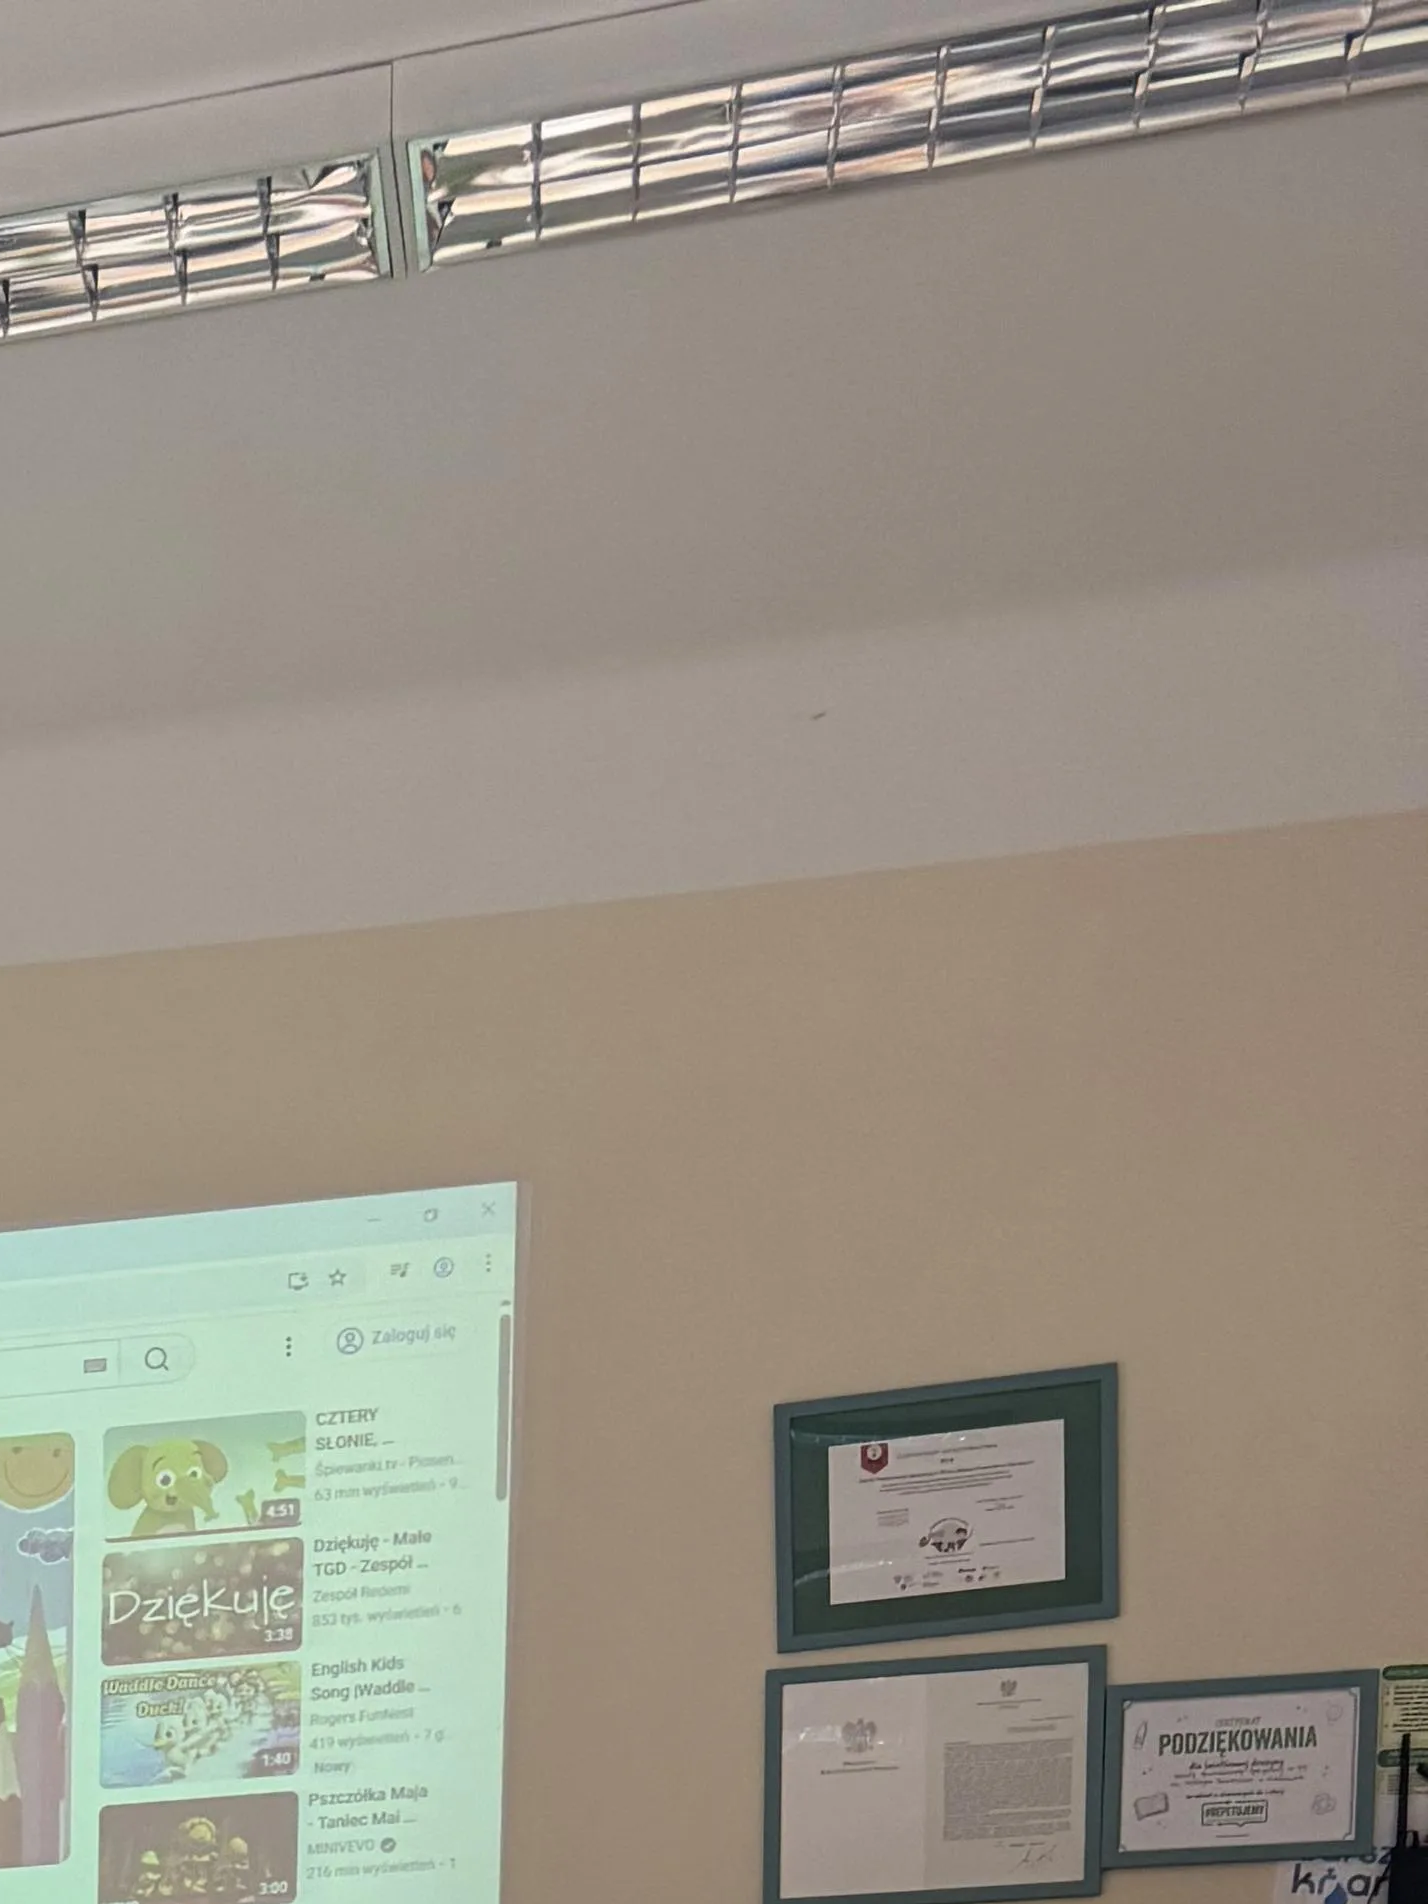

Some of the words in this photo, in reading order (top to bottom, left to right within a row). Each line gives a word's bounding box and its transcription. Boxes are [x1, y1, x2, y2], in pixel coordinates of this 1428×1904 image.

[372, 1328, 431, 1346] Zaloguj
[434, 1324, 456, 1342] się
[316, 1407, 379, 1426] CZTERY
[266, 1504, 295, 1518] 4:51
[314, 1536, 380, 1555] Dziękuję
[314, 1562, 347, 1576] TGD
[360, 1556, 413, 1575] Zespół
[108, 1574, 295, 1631] Dziękuję
[265, 1627, 294, 1642] 3:38
[311, 1660, 368, 1679] English
[371, 1655, 405, 1672] Kids
[104, 1677, 163, 1695] Waddle
[167, 1674, 217, 1692] Dance
[310, 1685, 350, 1703] Song
[1158, 1725, 1318, 1758] PODZIĘKOWANIA
[262, 1752, 292, 1766] 1:40
[308, 1788, 387, 1807] Pszczółka
[390, 1785, 429, 1804] Maja
[319, 1813, 368, 1830] Taniec
[259, 1880, 289, 1895] 3:00
